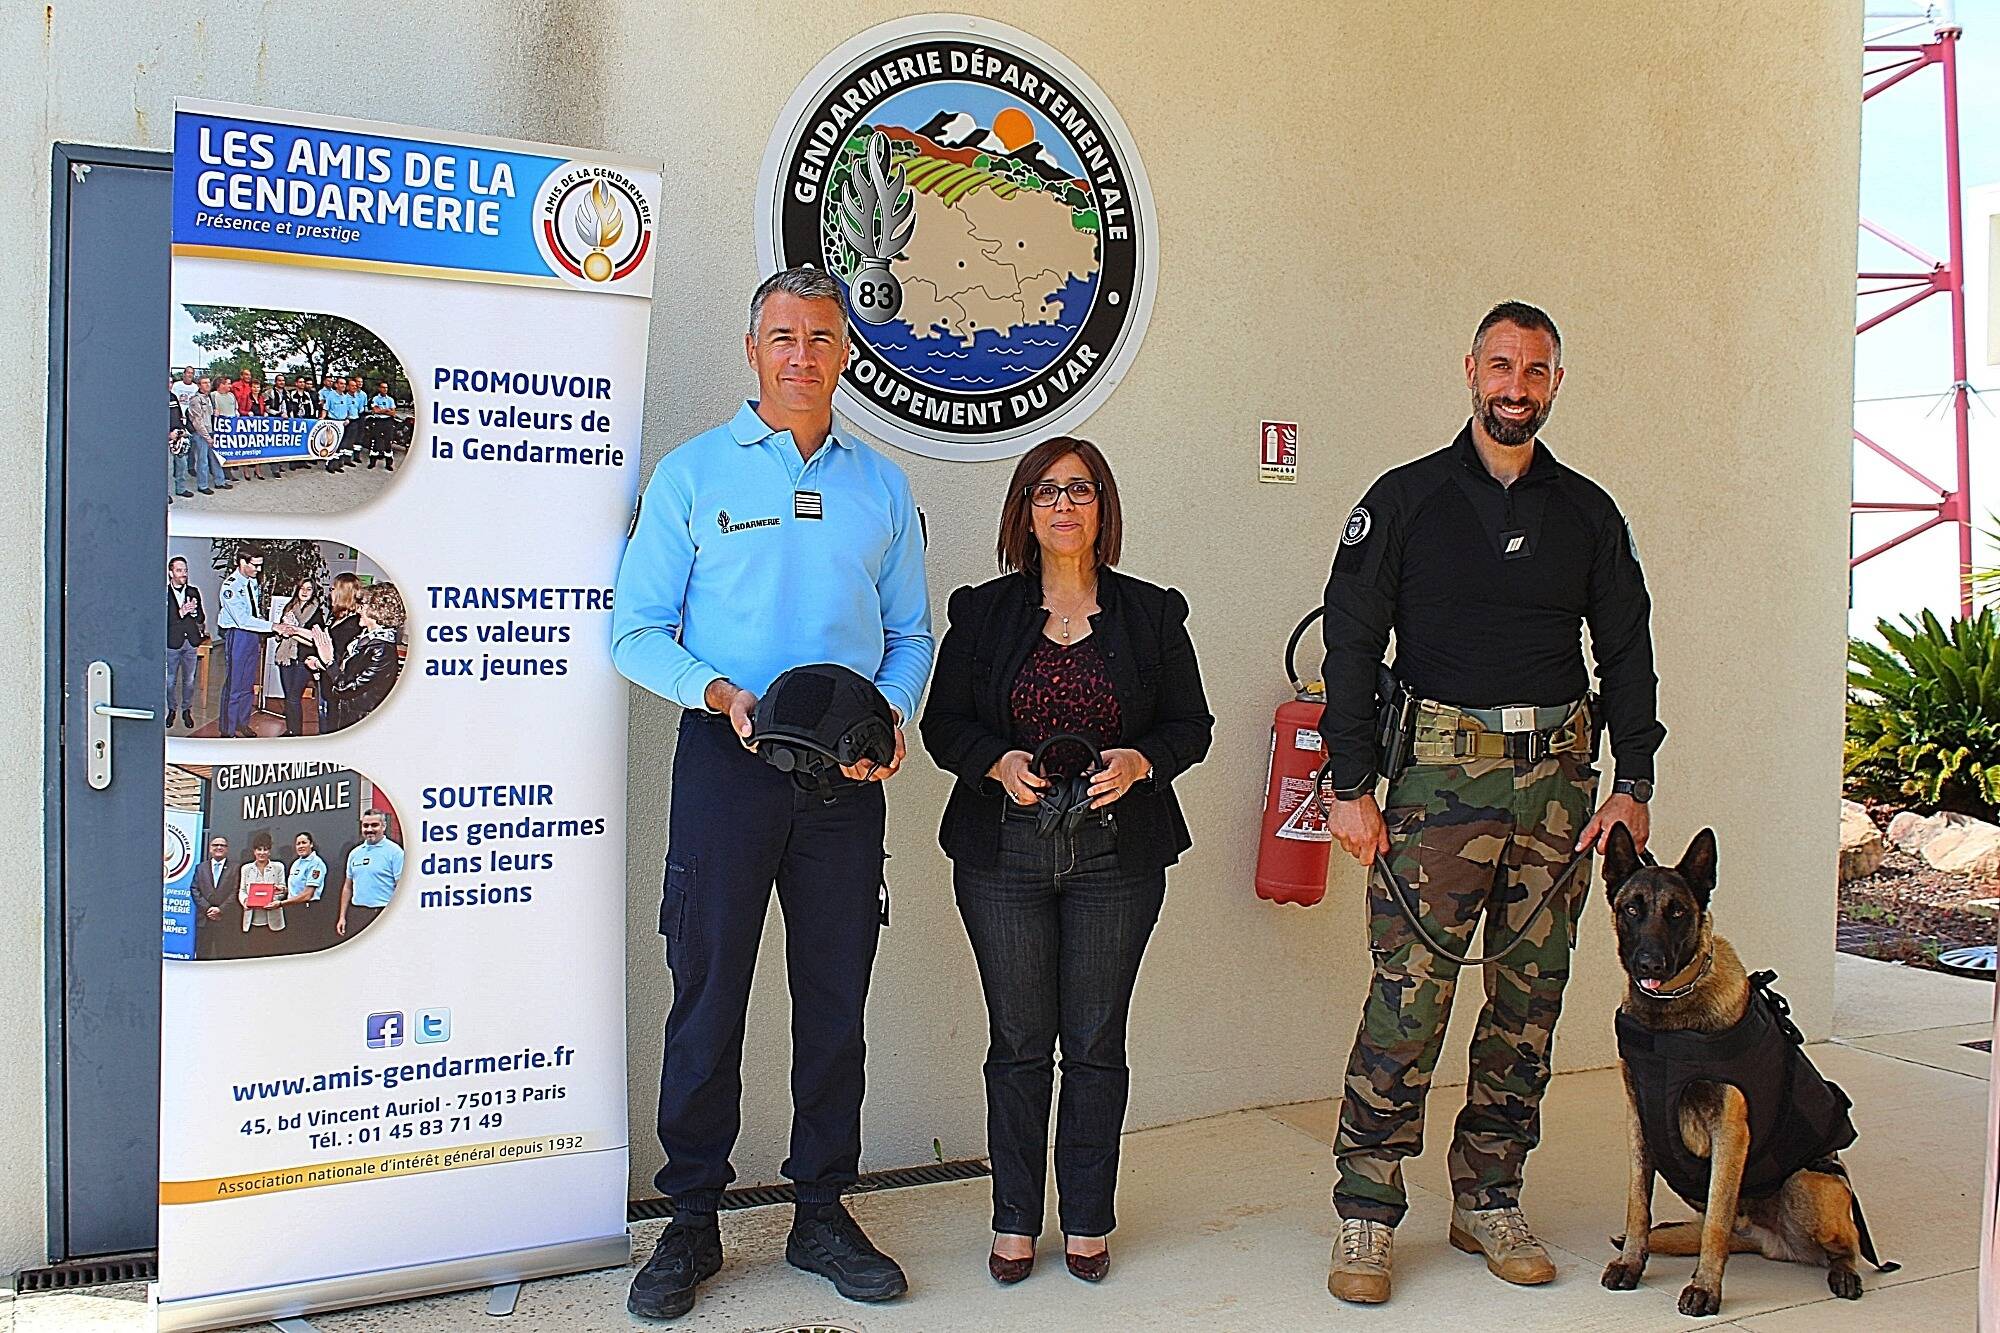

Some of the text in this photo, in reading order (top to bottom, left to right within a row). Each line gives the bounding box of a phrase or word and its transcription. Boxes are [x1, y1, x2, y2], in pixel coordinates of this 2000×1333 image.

[794, 47, 1128, 241] GENDARMERIE DÉPARTEMENTALE
[199, 127, 516, 198] LES AMIS DE LA
[198, 171, 500, 236] GENDARMERIE
[545, 168, 651, 225] AMIS DE LA GENDARMERIE
[196, 213, 361, 243] Présence et prestige
[860, 283, 893, 309] 83
[434, 367, 612, 400] PROMOUVOIR
[846, 342, 1099, 426] ROUPEMENT DU VAR
[214, 418, 231, 432] LES
[236, 419, 269, 433] AMIS
[273, 420, 287, 432] DE
[292, 420, 307, 433] LA
[433, 402, 610, 432] les valeurs de
[213, 434, 302, 448] GENDARMERIE
[431, 435, 624, 466] la Gendarmerie
[722, 518, 780, 533] GENDARMERIE
[427, 586, 613, 609] TRANSMETTRE
[426, 621, 570, 642] ces valeurs
[425, 654, 568, 681] aux jeunes
[243, 781, 350, 819] NATIONALE
[422, 784, 553, 809] SOUTENIR
[422, 817, 605, 845] les gendarmes
[421, 851, 553, 875] dans leurs
[167, 889, 191, 897] prestig
[421, 883, 532, 908] missions
[233, 1046, 574, 1101] www.amis-gendarmerie.fr
[240, 1118, 272, 1135] 45,
[278, 1113, 300, 1131] bd
[307, 1104, 379, 1127] Vincent
[385, 1097, 440, 1118] Auriol
[457, 1089, 516, 1109] 75013
[523, 1084, 566, 1102] Paris
[309, 1131, 342, 1149] Tél.
[359, 1126, 380, 1143] 01
[390, 1122, 413, 1139] 45
[420, 1119, 443, 1136] 83
[450, 1116, 470, 1132] 71
[479, 1112, 502, 1129] 49
[218, 1173, 303, 1194] Association
[308, 1162, 375, 1182] nationale
[444, 1147, 495, 1166] général
[499, 1141, 543, 1158] depuis
[548, 1136, 583, 1150] 1932
